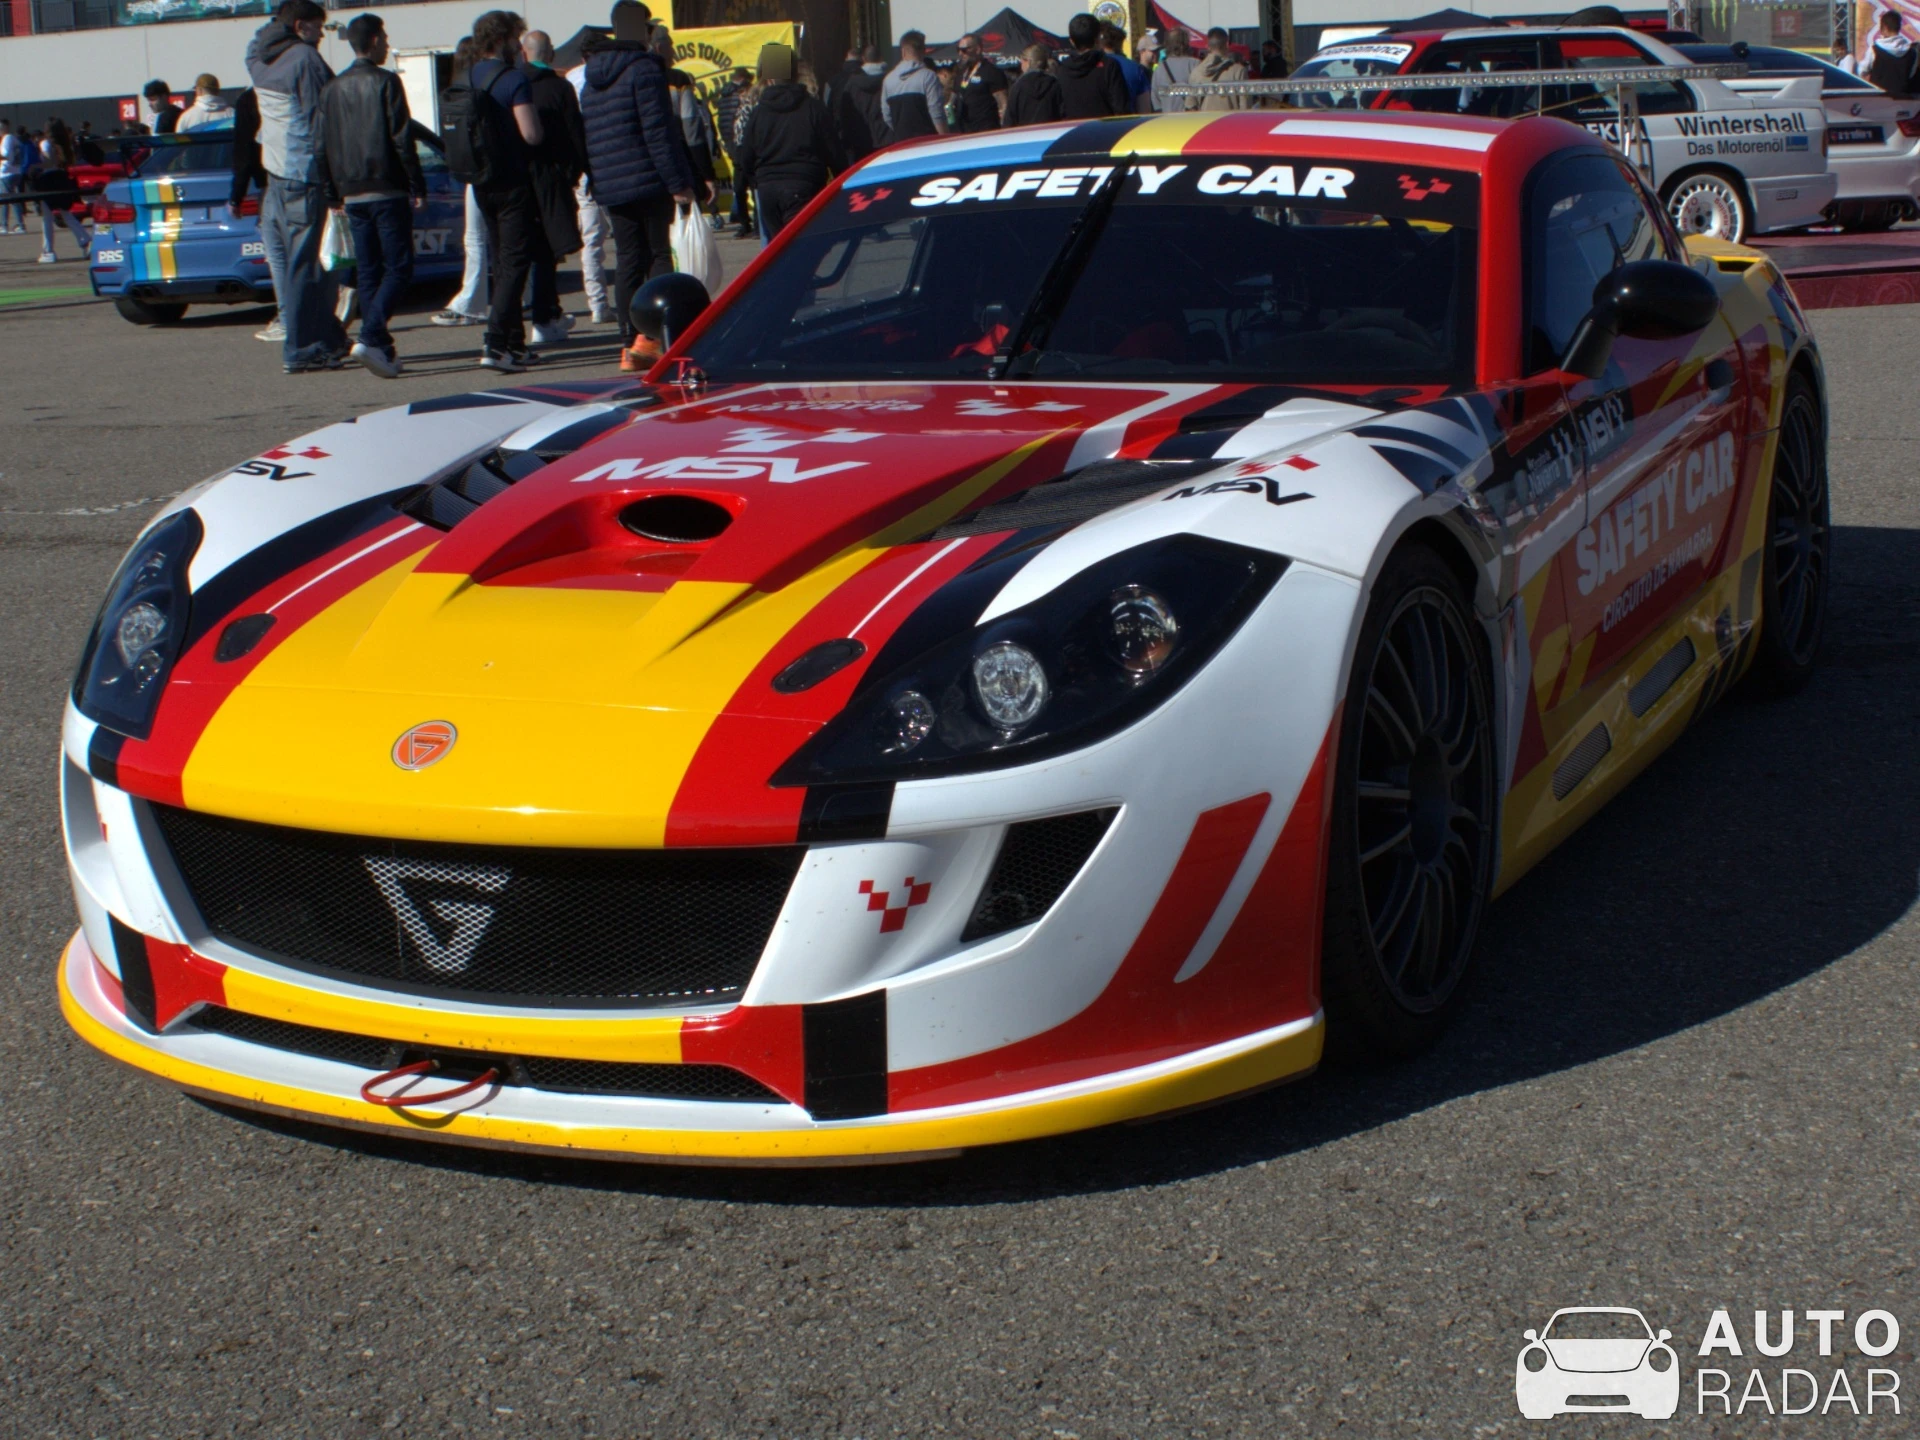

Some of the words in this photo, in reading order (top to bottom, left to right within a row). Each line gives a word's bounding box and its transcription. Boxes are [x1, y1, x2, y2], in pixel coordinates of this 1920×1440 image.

[1780, 16, 1796, 34] 12
[698, 42, 732, 70] TOUR
[122, 104, 136, 118] 20
[1675, 112, 1808, 137] Wintershall
[1688, 142, 1714, 156] Das
[1717, 137, 1784, 155] Motorenöl
[910, 164, 1187, 208] SAFETY
[1197, 165, 1355, 200] CAR
[570, 456, 871, 484] MSV
[1161, 476, 1316, 506] MSV
[1576, 459, 1679, 597] SAFETY
[1684, 431, 1736, 514] CAR
[1603, 570, 1653, 633] CIRCUITO
[1653, 562, 1667, 592] DE
[1667, 523, 1713, 577] NAVARRA
